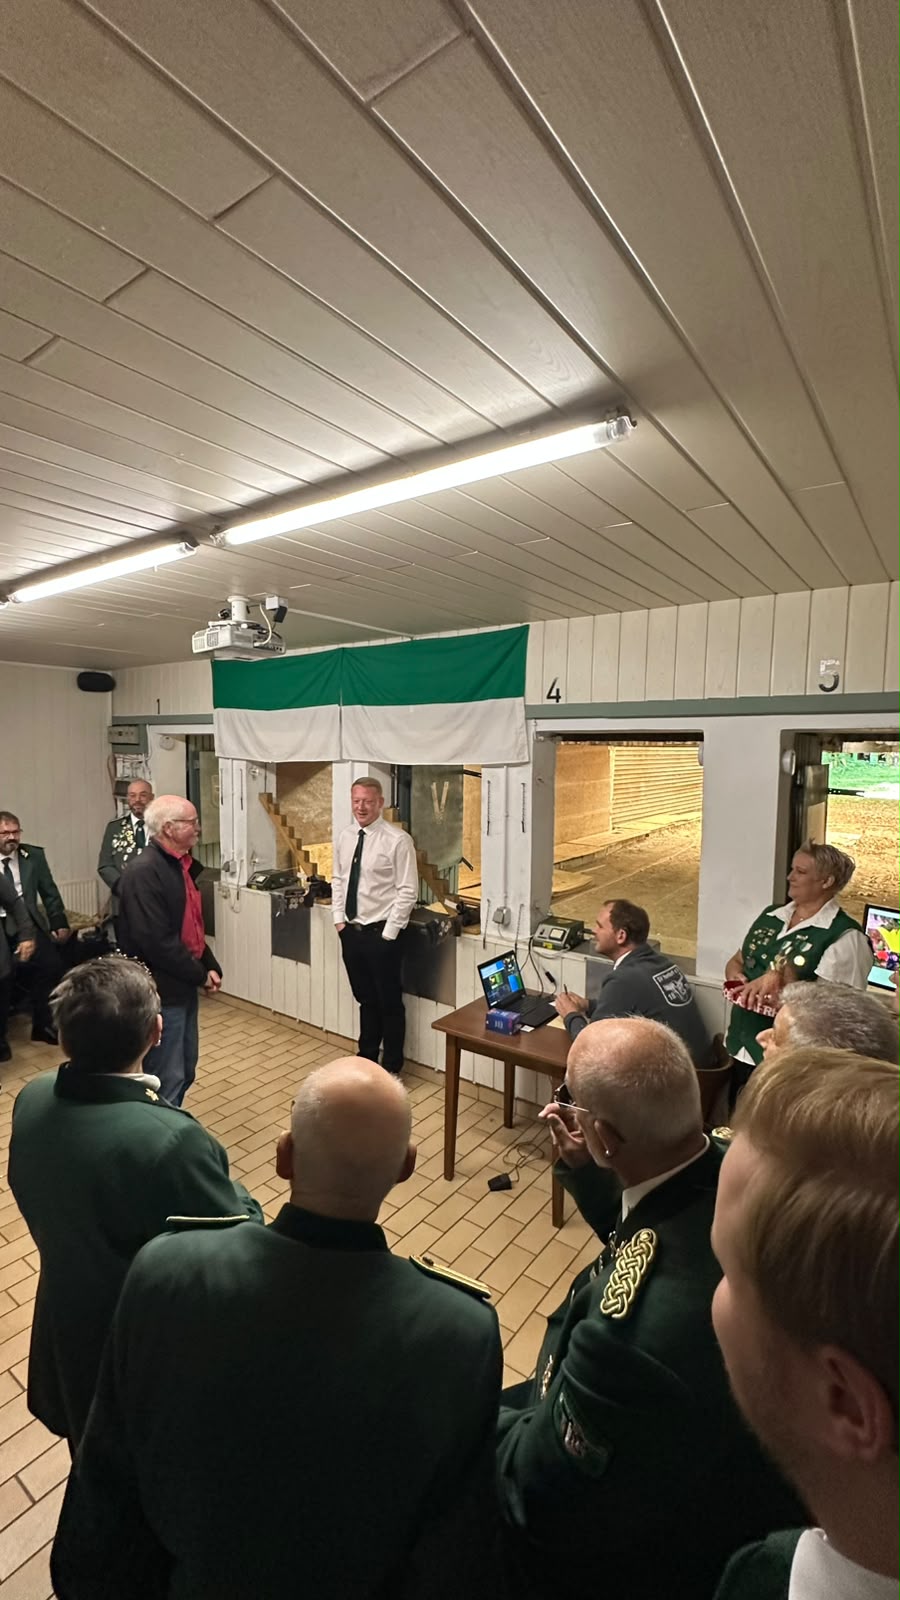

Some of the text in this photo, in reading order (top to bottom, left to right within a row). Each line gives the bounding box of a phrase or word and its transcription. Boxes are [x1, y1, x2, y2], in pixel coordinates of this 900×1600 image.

[546, 676, 561, 703] 4
[818, 659, 841, 693] 5
[156, 698, 161, 715] 1
